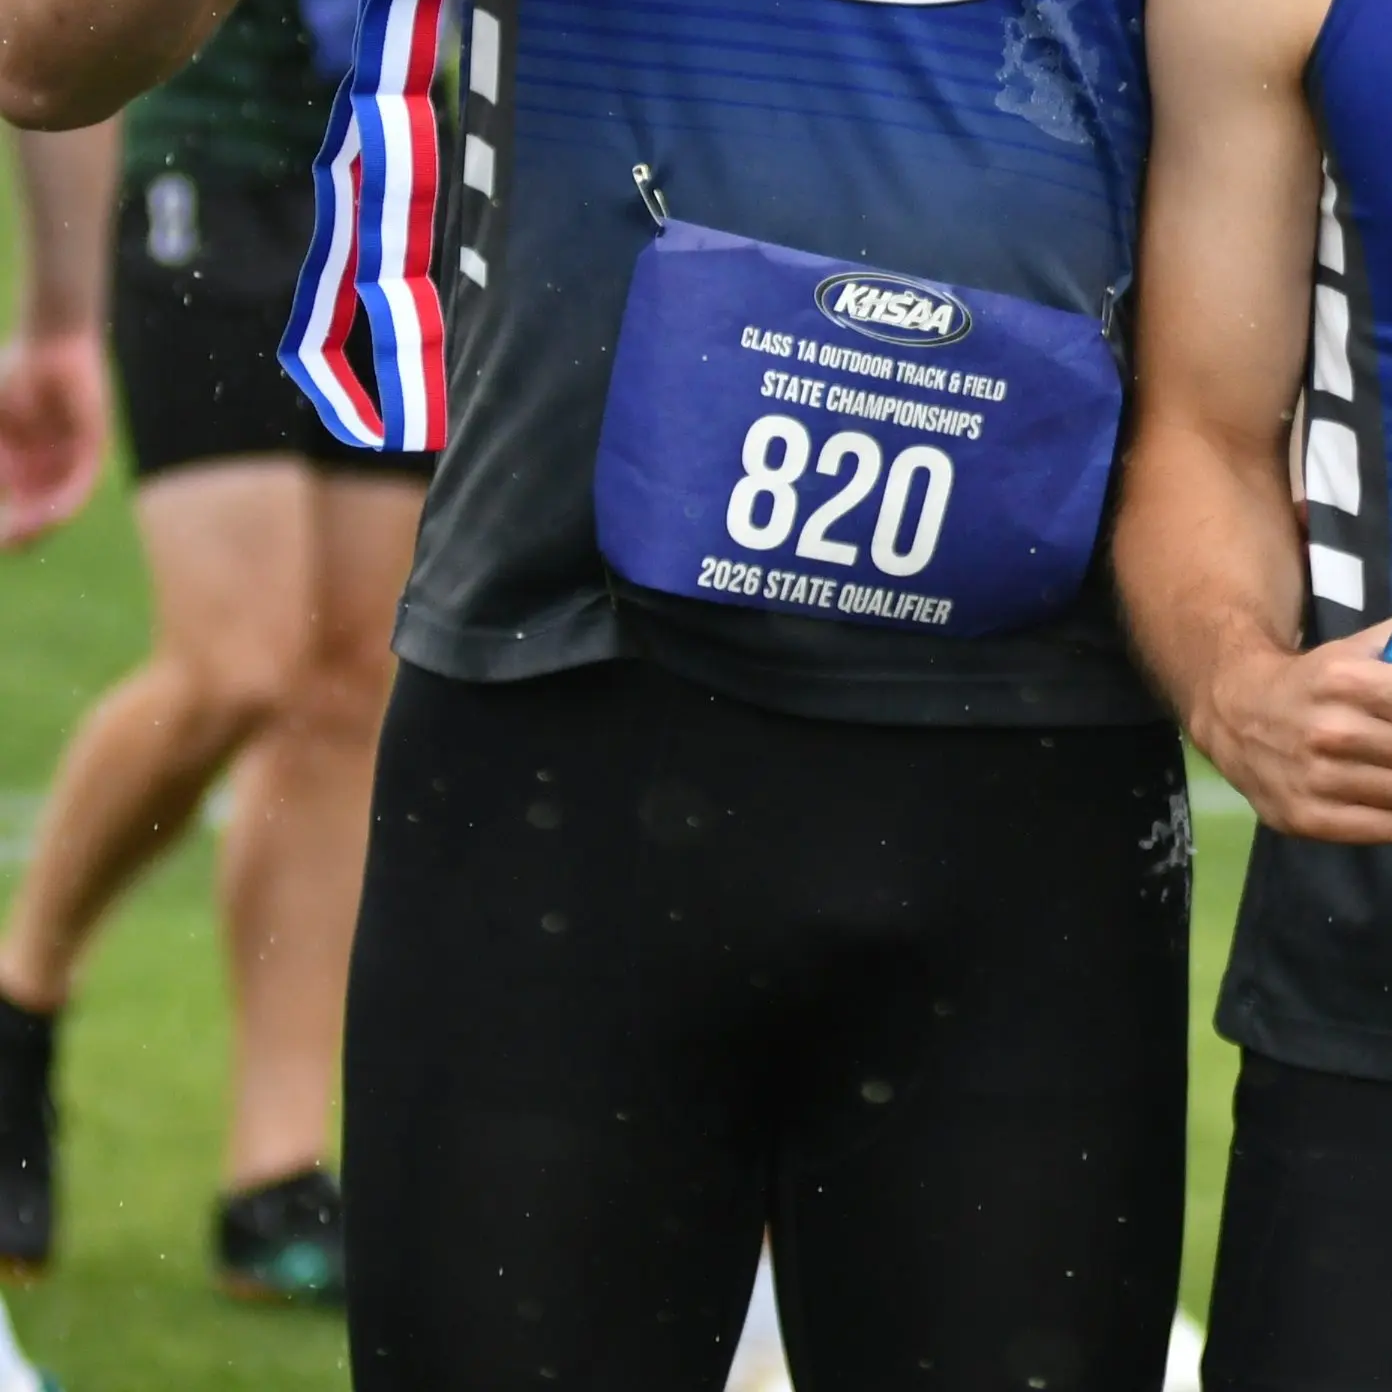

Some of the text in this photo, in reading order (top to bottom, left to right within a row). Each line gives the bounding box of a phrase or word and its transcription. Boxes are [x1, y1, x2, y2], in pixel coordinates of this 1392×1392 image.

[833, 283, 954, 335] KHSAA
[741, 326, 1006, 401] CLASS 1A OUTDOOR TRACK & FIELD
[761, 370, 983, 440] STATE CHAMPIONSHIPS
[726, 415, 954, 577] 820
[698, 558, 952, 626] 2026 STATE QUALIFIER
